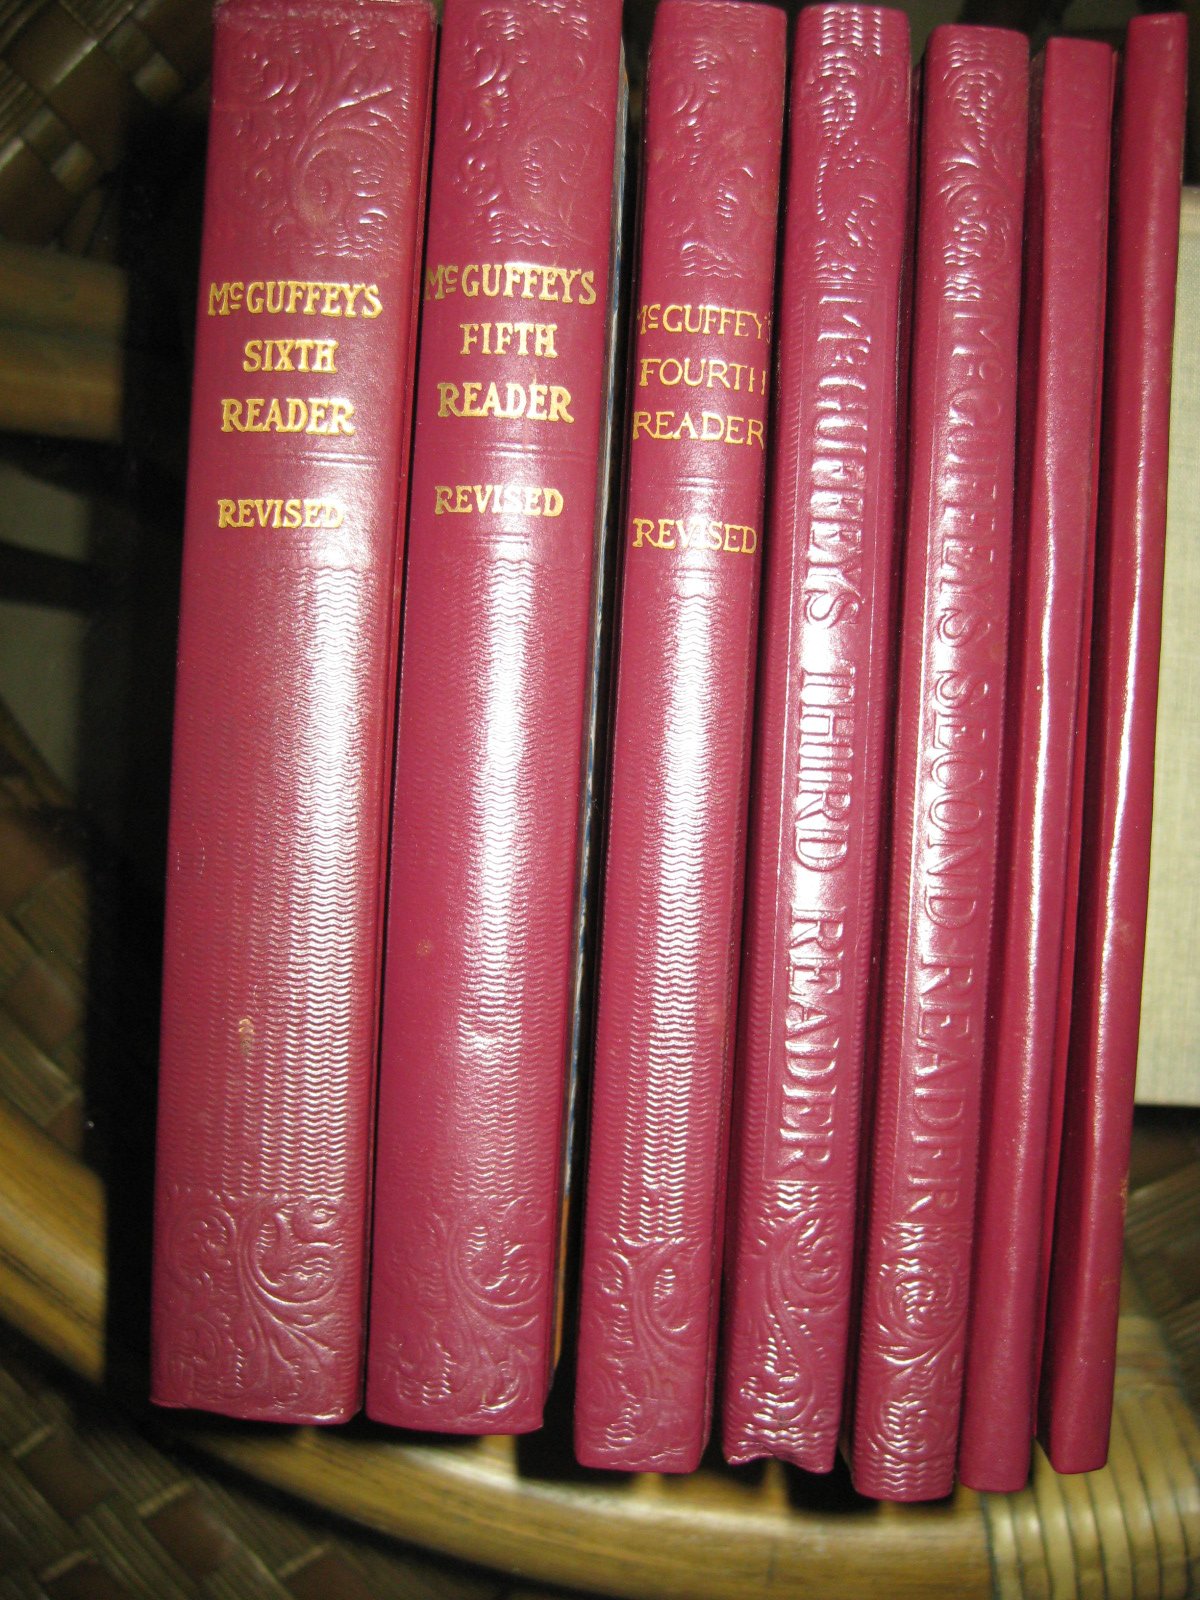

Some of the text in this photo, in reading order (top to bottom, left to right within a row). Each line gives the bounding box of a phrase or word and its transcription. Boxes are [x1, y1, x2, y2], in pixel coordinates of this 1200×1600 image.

[243, 339, 339, 373] SIXTH
[459, 322, 558, 358] FIFTH
[639, 358, 767, 395] FOURTH
[220, 398, 355, 435] READER
[437, 382, 575, 423] READER
[633, 411, 764, 449] READER
[217, 499, 344, 528] REVISED
[434, 485, 564, 517] REVISED
[632, 518, 757, 554] REVISED
[794, 667, 856, 872] THIRD
[924, 671, 989, 929] SECOND
[779, 909, 844, 1171] READER
[907, 954, 974, 1216] READER
